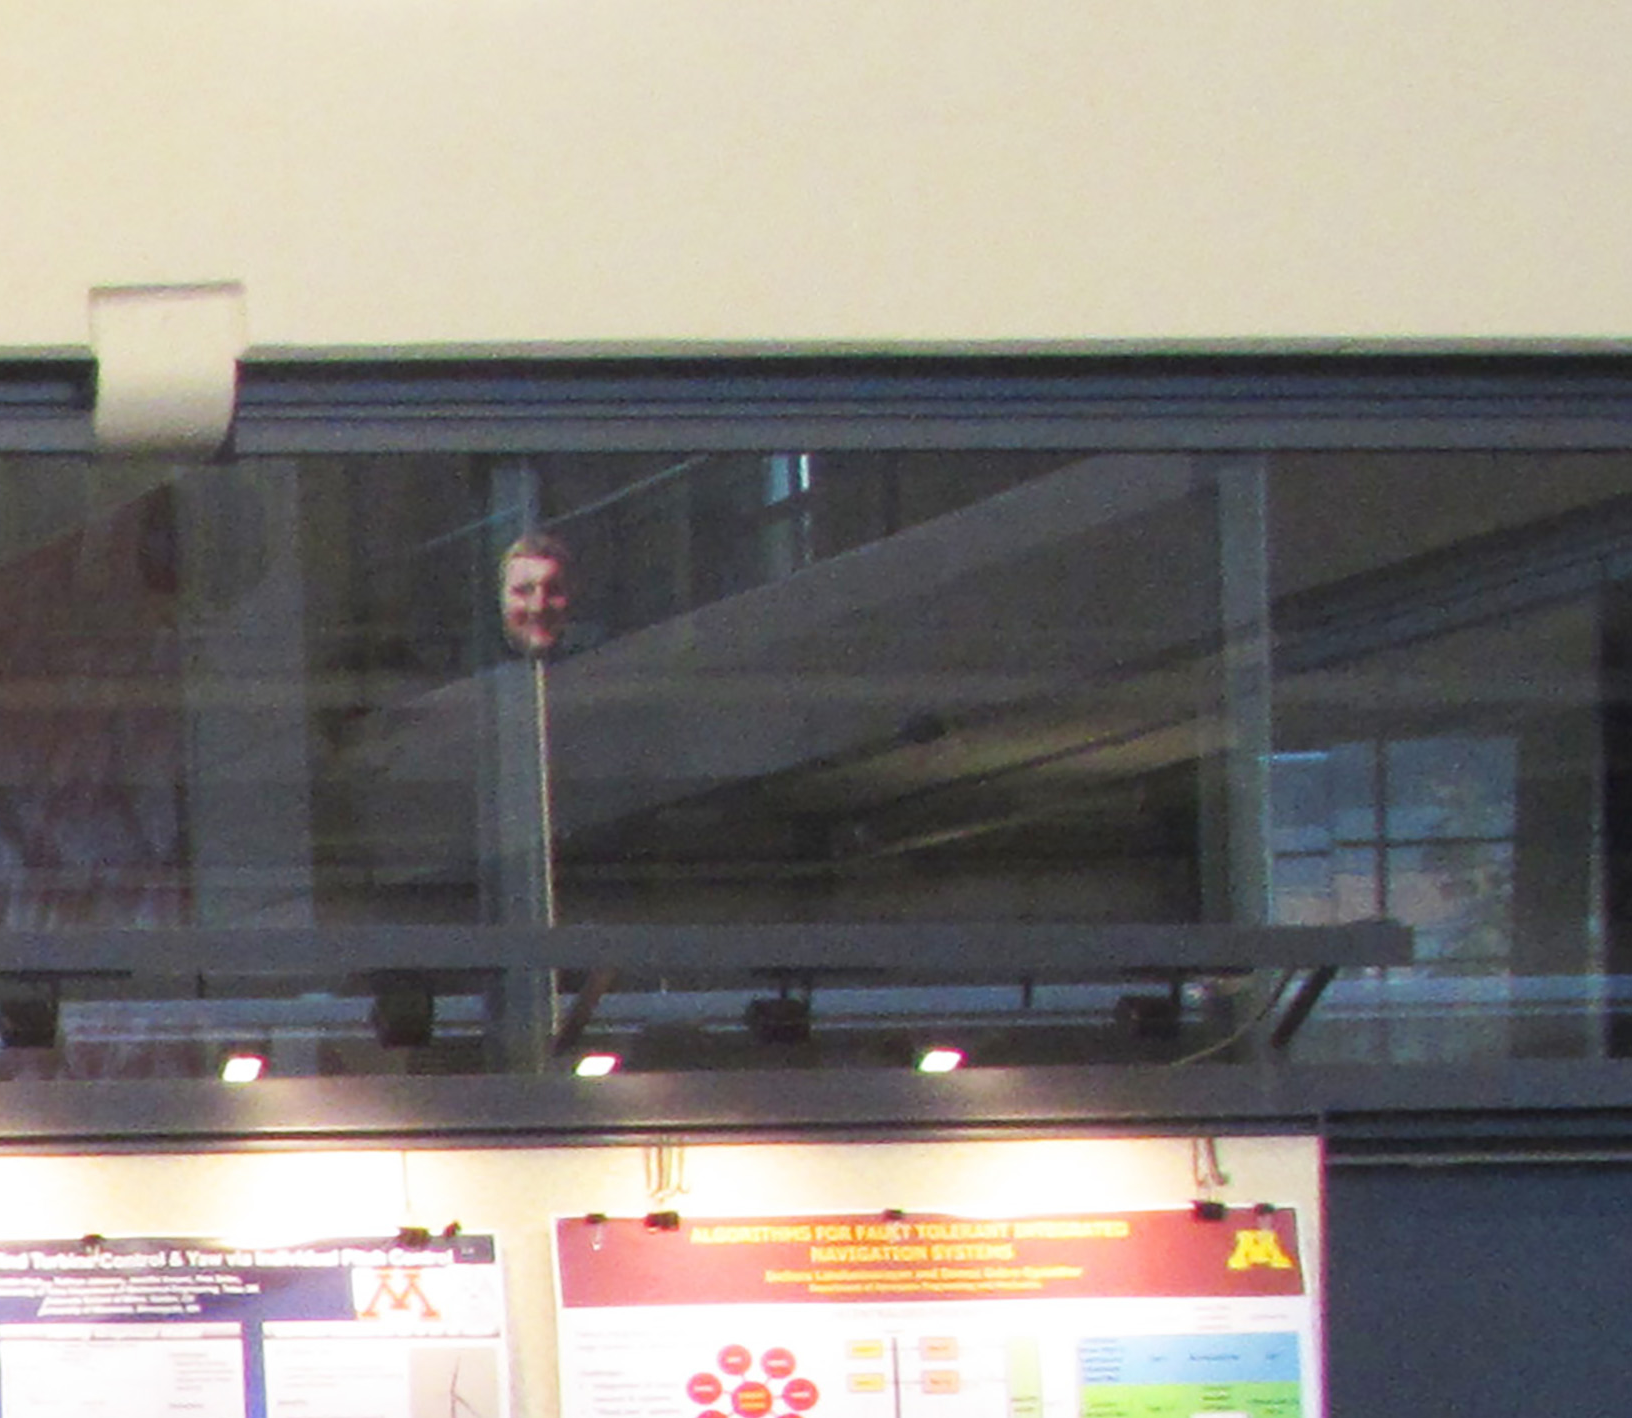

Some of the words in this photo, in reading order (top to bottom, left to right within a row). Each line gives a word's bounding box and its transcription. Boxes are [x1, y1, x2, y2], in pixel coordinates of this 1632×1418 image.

[690, 1225, 811, 1244] ALGORITHMS
[815, 1225, 851, 1242] FOR
[855, 1223, 912, 1242] FAULT
[915, 1221, 1009, 1241] TOLERANT
[1014, 1220, 1130, 1239] INTEGRATED
[811, 1245, 927, 1263] NAVIGATION
[932, 1244, 1015, 1262] SYSTEMS
